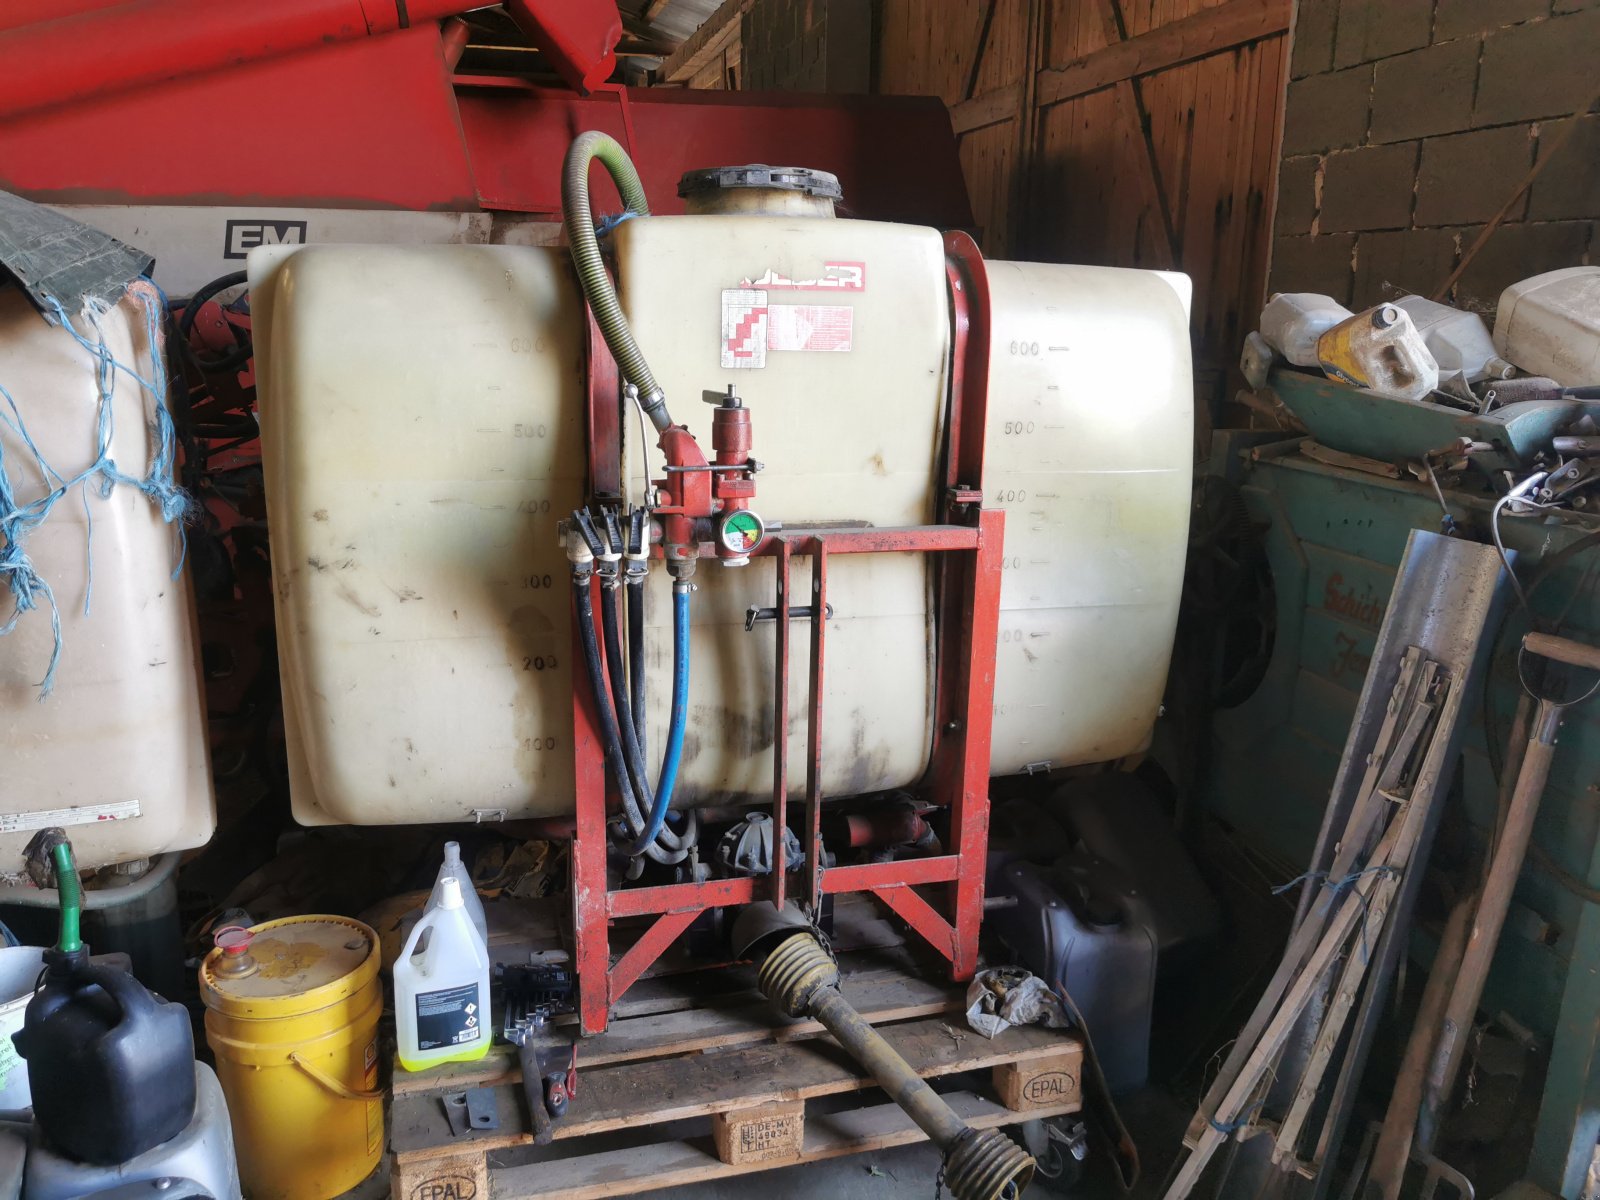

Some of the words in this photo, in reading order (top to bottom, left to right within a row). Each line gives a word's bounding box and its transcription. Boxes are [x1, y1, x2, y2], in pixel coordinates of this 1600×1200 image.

[1010, 340, 1039, 356] 600
[513, 423, 547, 438] 500
[1004, 421, 1035, 435] 500
[997, 489, 1026, 503] 400
[522, 654, 558, 671] 200
[524, 736, 556, 751] 100
[1031, 1078, 1067, 1099] EPAL
[757, 1119, 791, 1132] DE-MV
[757, 1140, 771, 1150] HT
[420, 1181, 469, 1200] EPAL
